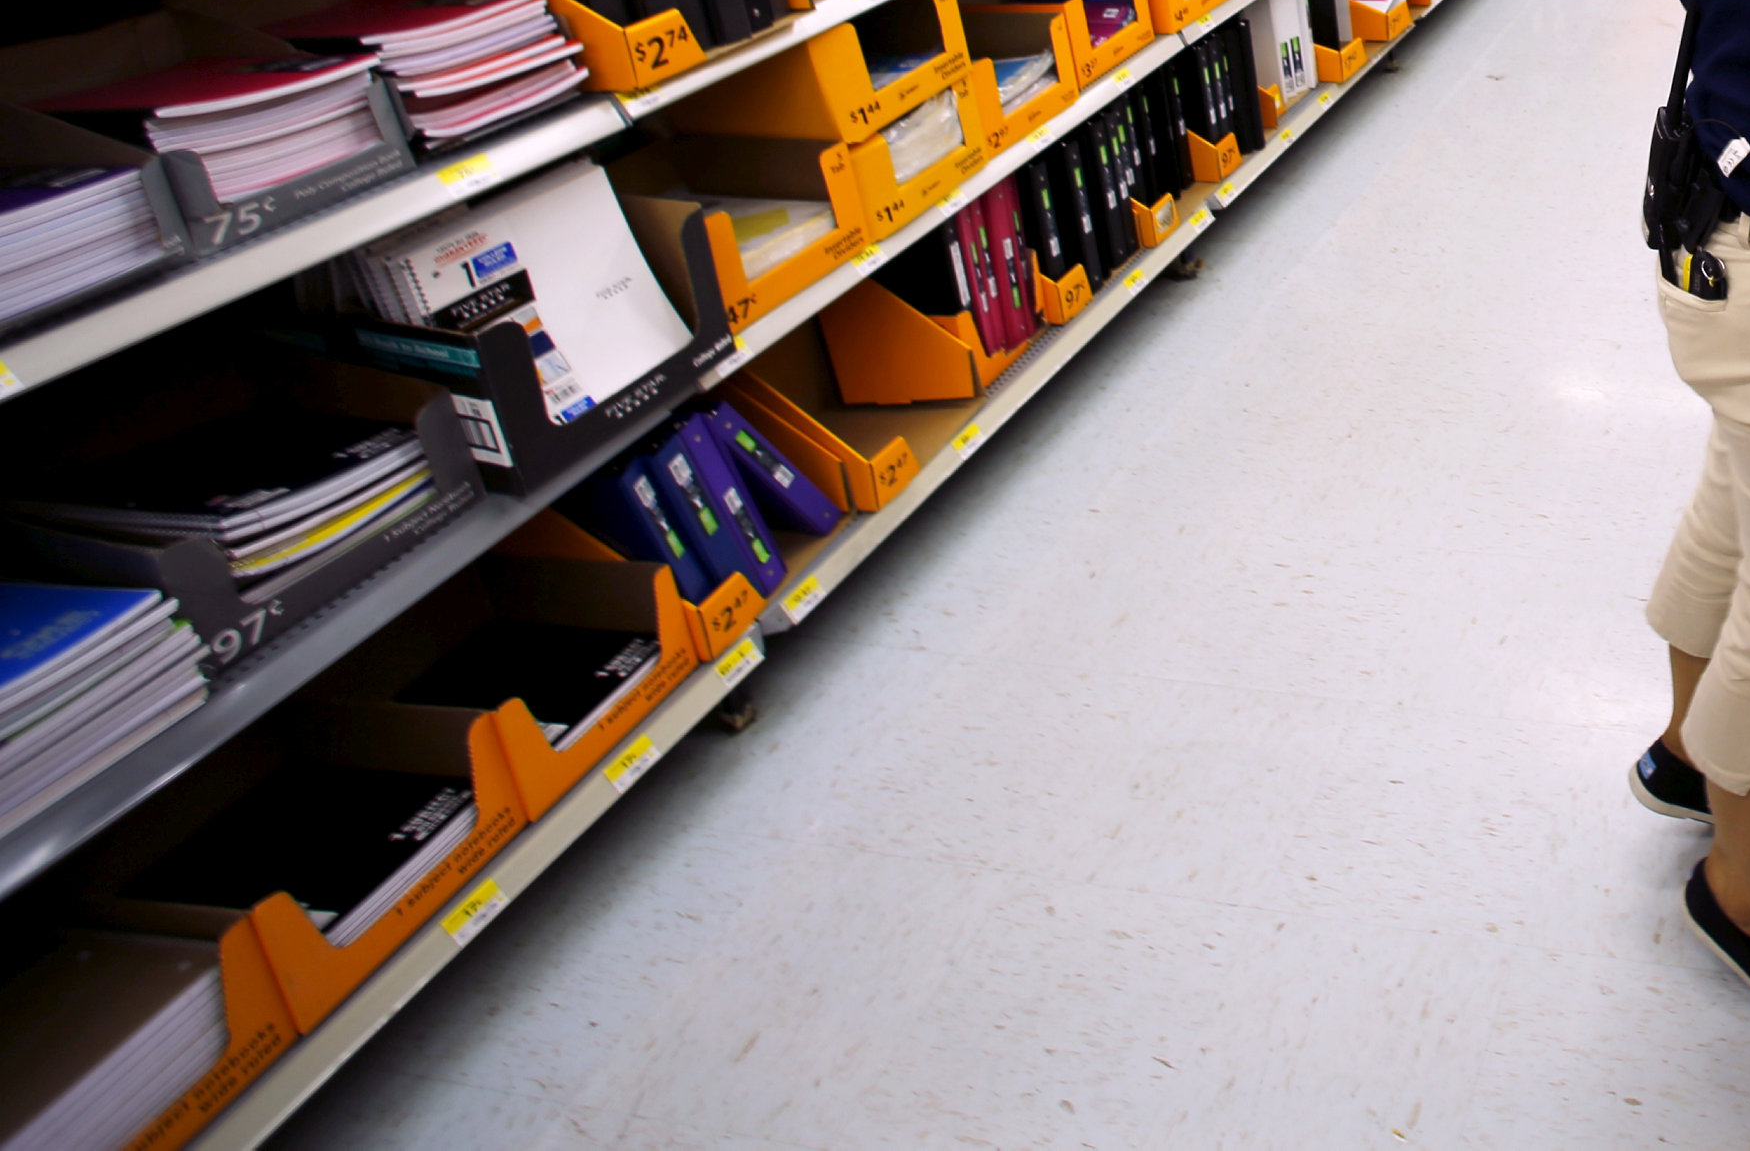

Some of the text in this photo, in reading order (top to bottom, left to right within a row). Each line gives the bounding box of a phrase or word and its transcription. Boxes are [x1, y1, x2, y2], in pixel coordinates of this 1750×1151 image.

[405, 861, 453, 907] subject
[453, 806, 512, 863] notebooks
[457, 816, 516, 875] wide ruled
[193, 1022, 276, 1099] notebooks
[198, 1033, 282, 1114] wide ruled
